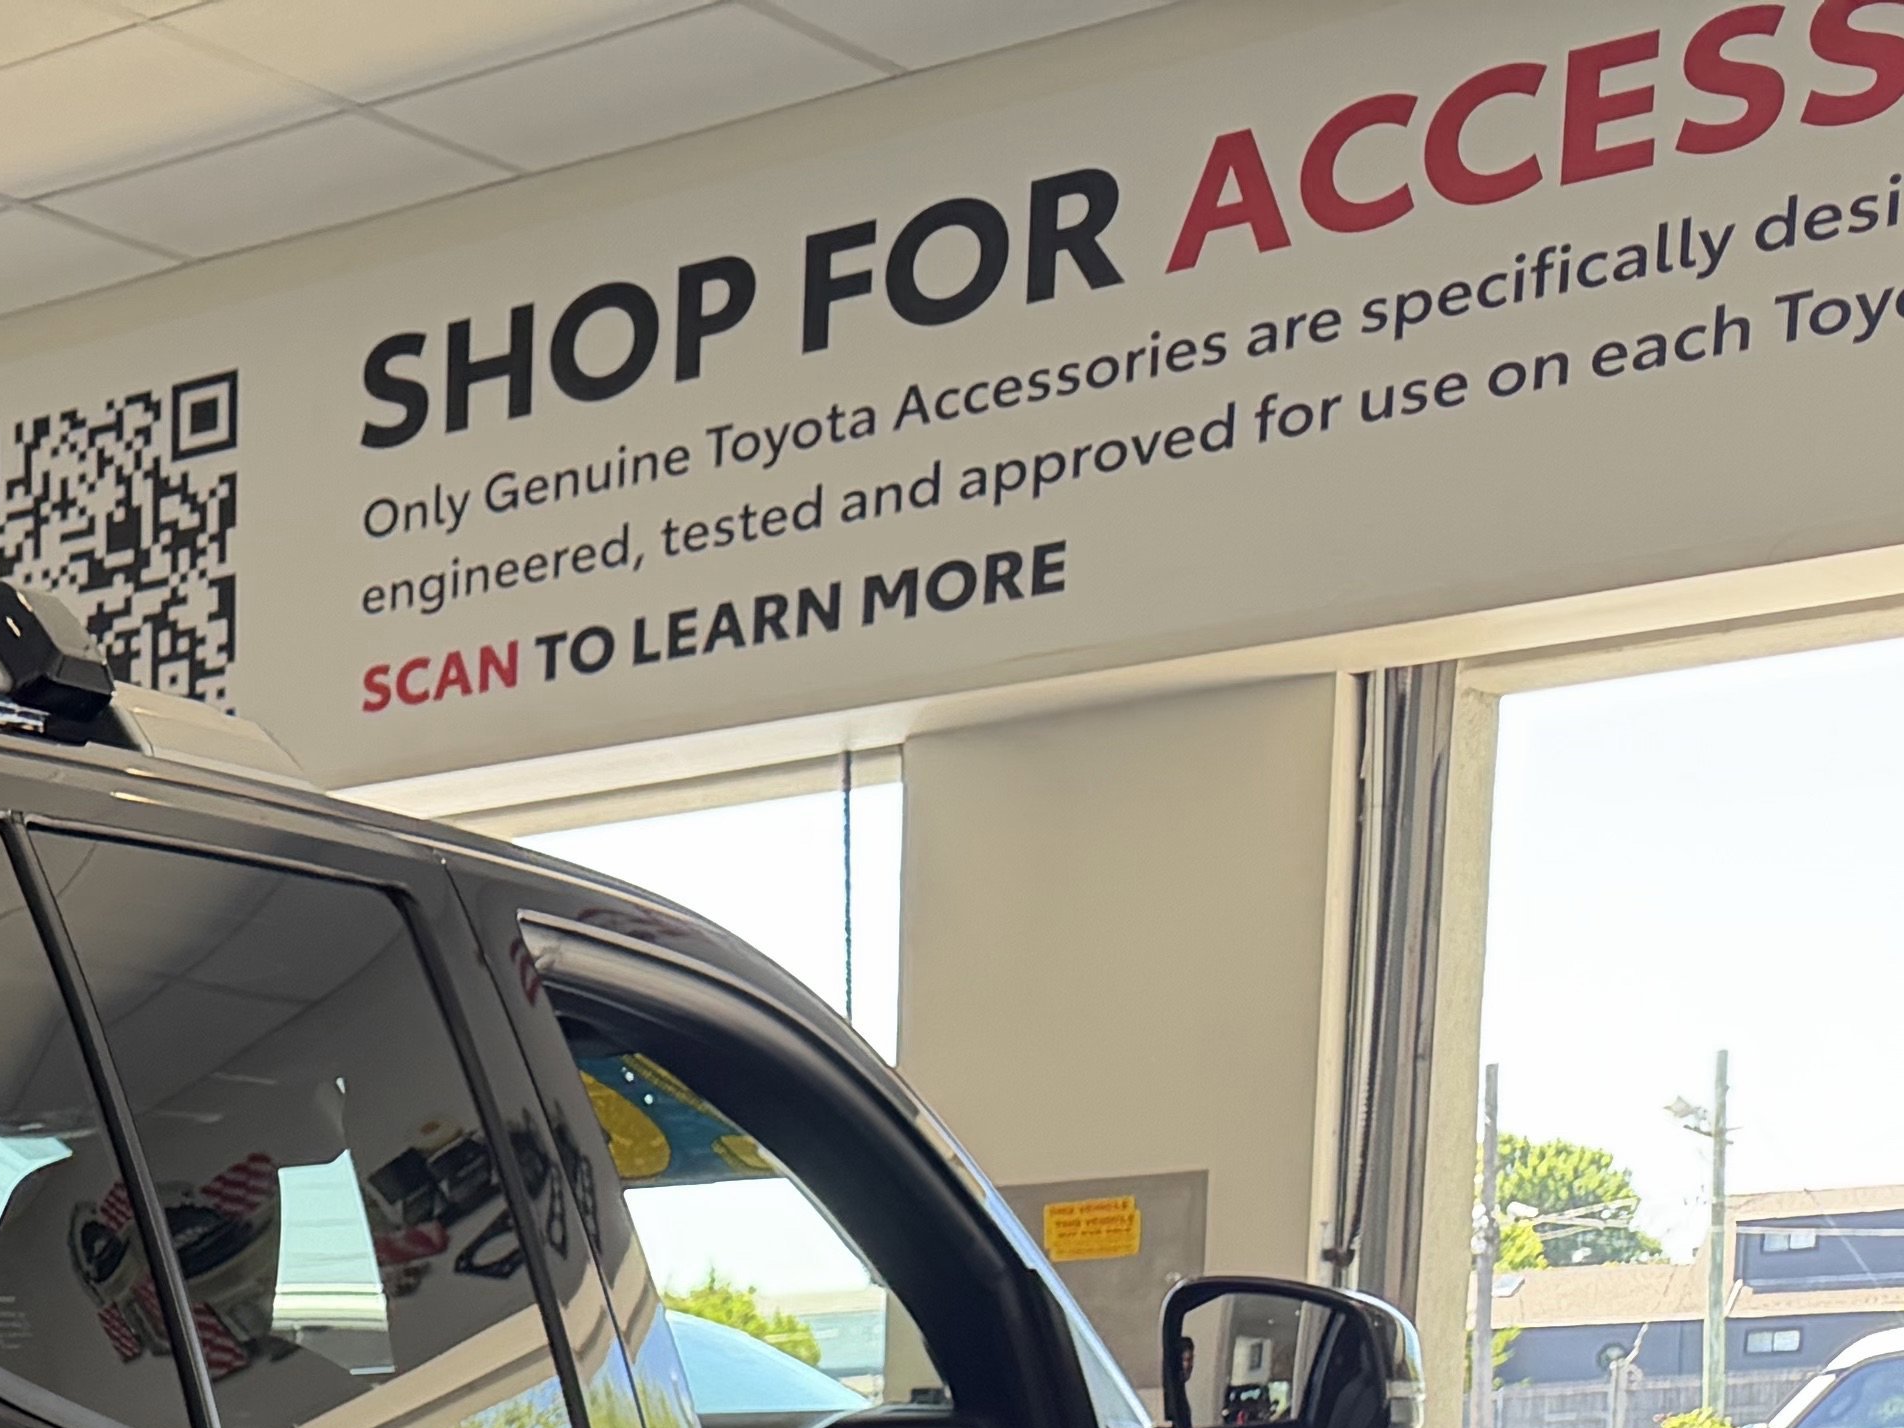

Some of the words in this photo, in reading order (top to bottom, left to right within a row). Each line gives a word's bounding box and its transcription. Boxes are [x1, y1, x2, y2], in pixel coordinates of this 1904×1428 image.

[360, 255, 757, 450] SHOP
[801, 168, 1125, 355] FOR
[1165, 0, 1904, 275] ACCESS
[363, 483, 471, 538] Only
[484, 445, 690, 513] Genuine
[705, 403, 876, 470] Toyota
[892, 330, 1227, 431] Accessories
[1247, 308, 1342, 357] are
[1361, 216, 1736, 341] specifically
[1754, 173, 1904, 252] desi
[362, 522, 644, 615] engineered,
[661, 483, 823, 557] tested
[840, 459, 941, 523] and
[959, 401, 1236, 507] approved
[1254, 392, 1343, 443] for
[1360, 372, 1468, 423] use
[1488, 352, 1569, 397] on
[1591, 303, 1751, 378] each
[1774, 287, 1904, 344] Toy
[362, 640, 519, 713] SCAN
[534, 625, 615, 682] TO
[632, 581, 842, 666] LEARN
[861, 539, 1067, 627] MORE
